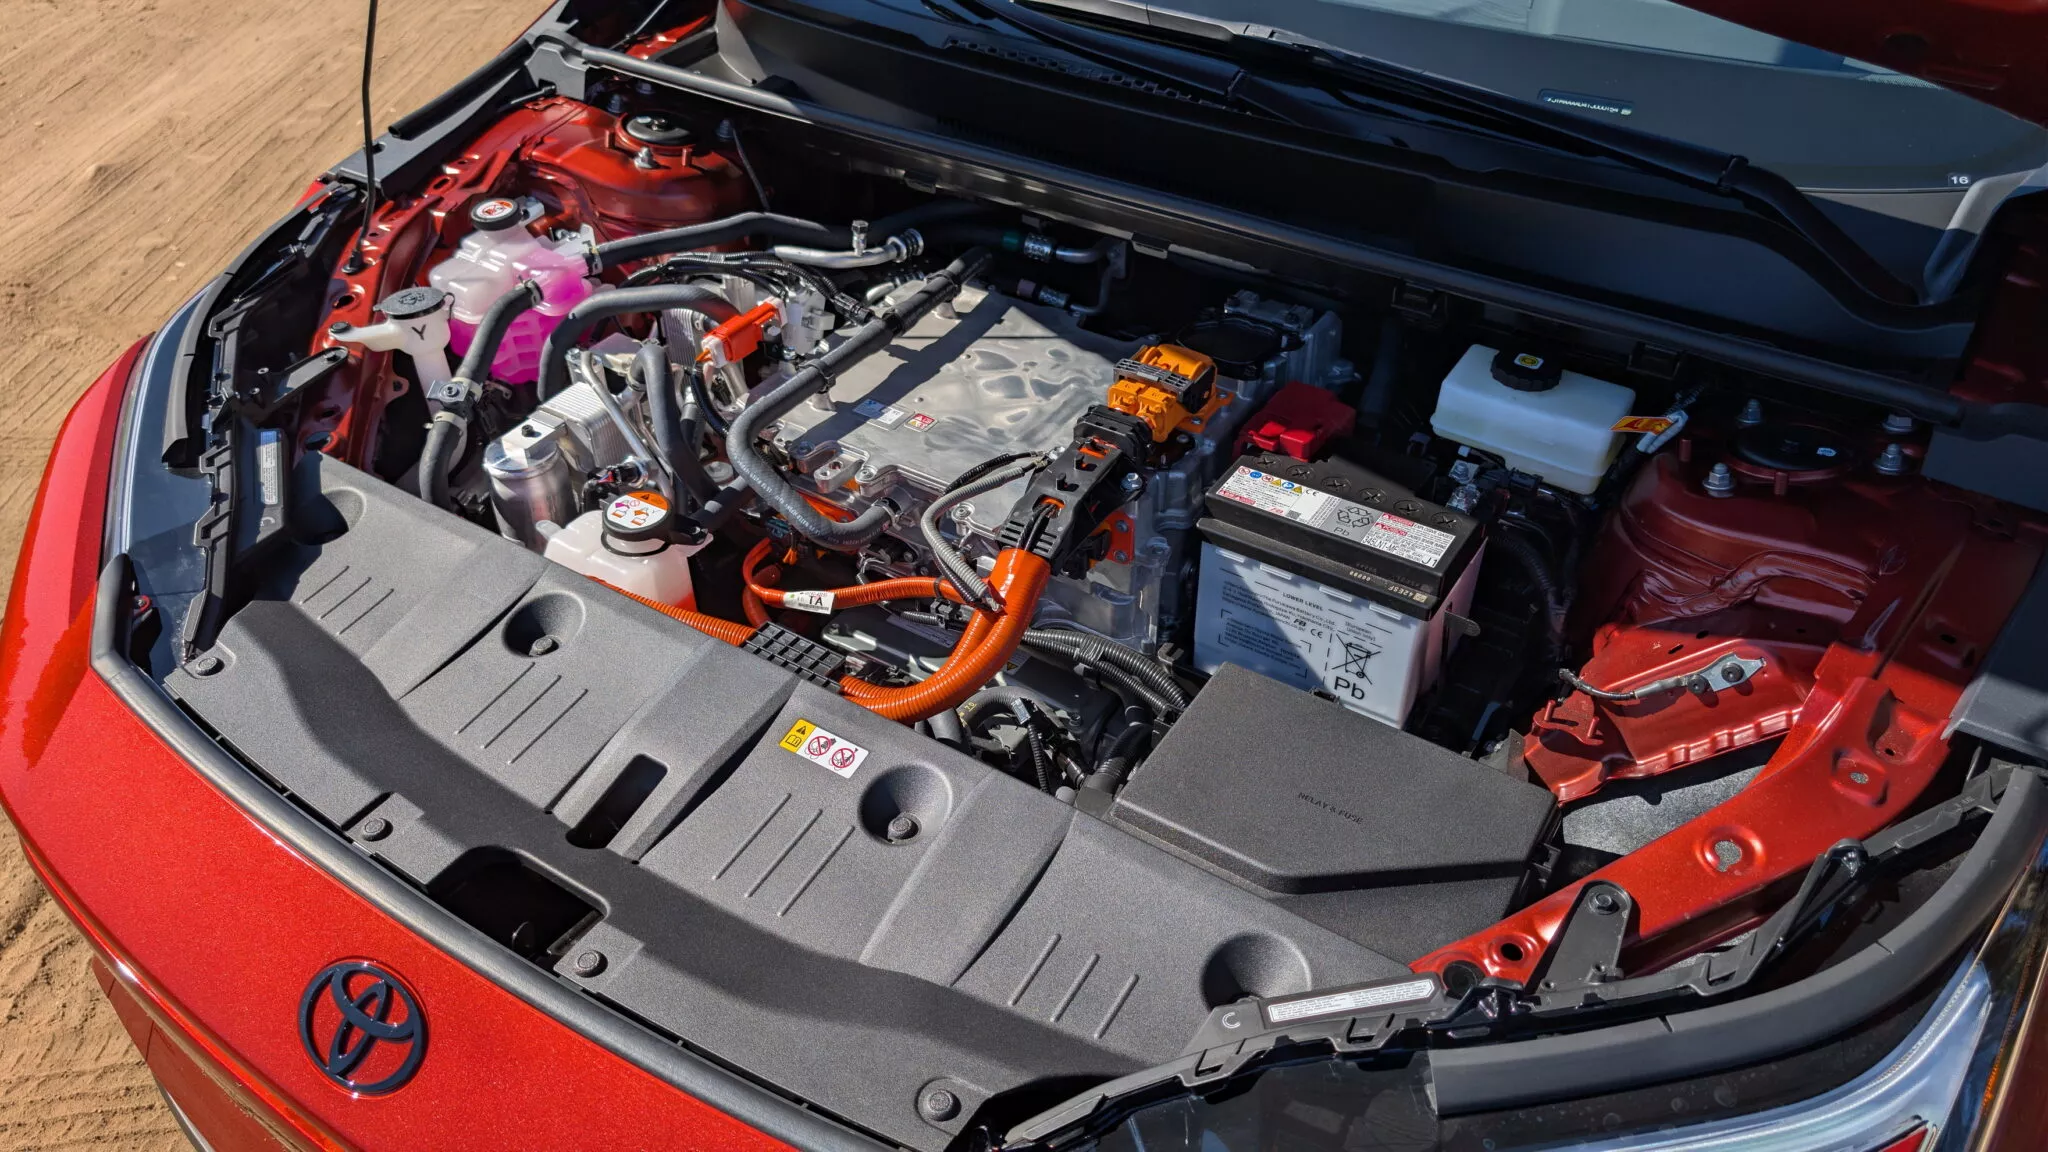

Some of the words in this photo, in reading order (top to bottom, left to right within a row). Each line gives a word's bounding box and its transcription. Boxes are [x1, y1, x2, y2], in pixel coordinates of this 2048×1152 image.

[1951, 176, 1969, 185] 16
[1333, 526, 1350, 537] Pb
[809, 595, 823, 606] TA
[1282, 591, 1305, 605] LOWER
[1304, 600, 1324, 612] LEVEL
[1333, 675, 1365, 700] Pb
[1337, 809, 1364, 825] FUSE
[1221, 1011, 1241, 1029] C
